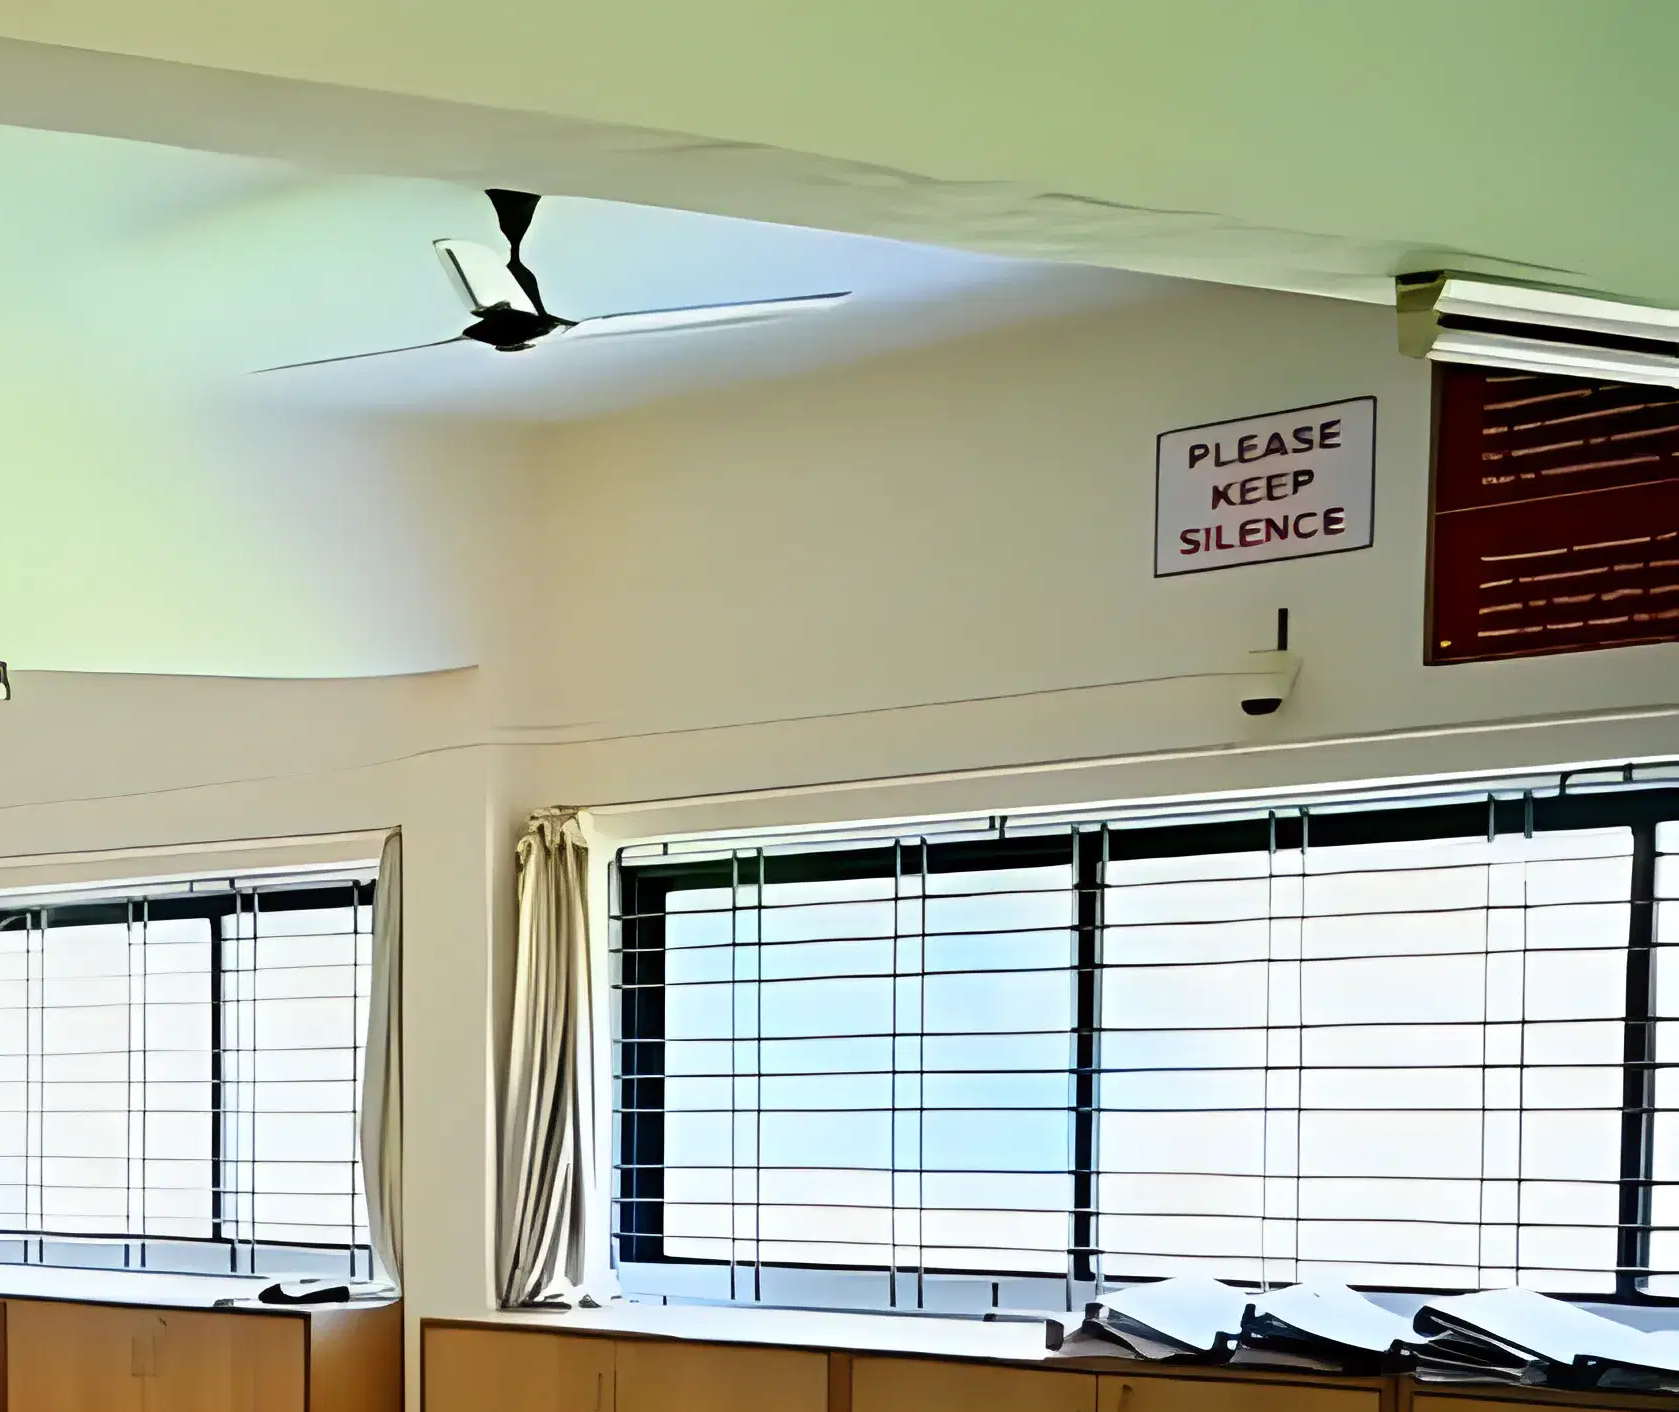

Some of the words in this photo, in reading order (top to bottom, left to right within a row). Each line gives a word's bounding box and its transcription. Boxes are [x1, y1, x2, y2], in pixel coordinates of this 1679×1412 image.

[1188, 418, 1342, 469] PLEASE
[1211, 469, 1315, 510] KEEP
[1179, 507, 1347, 555] SILENCE
